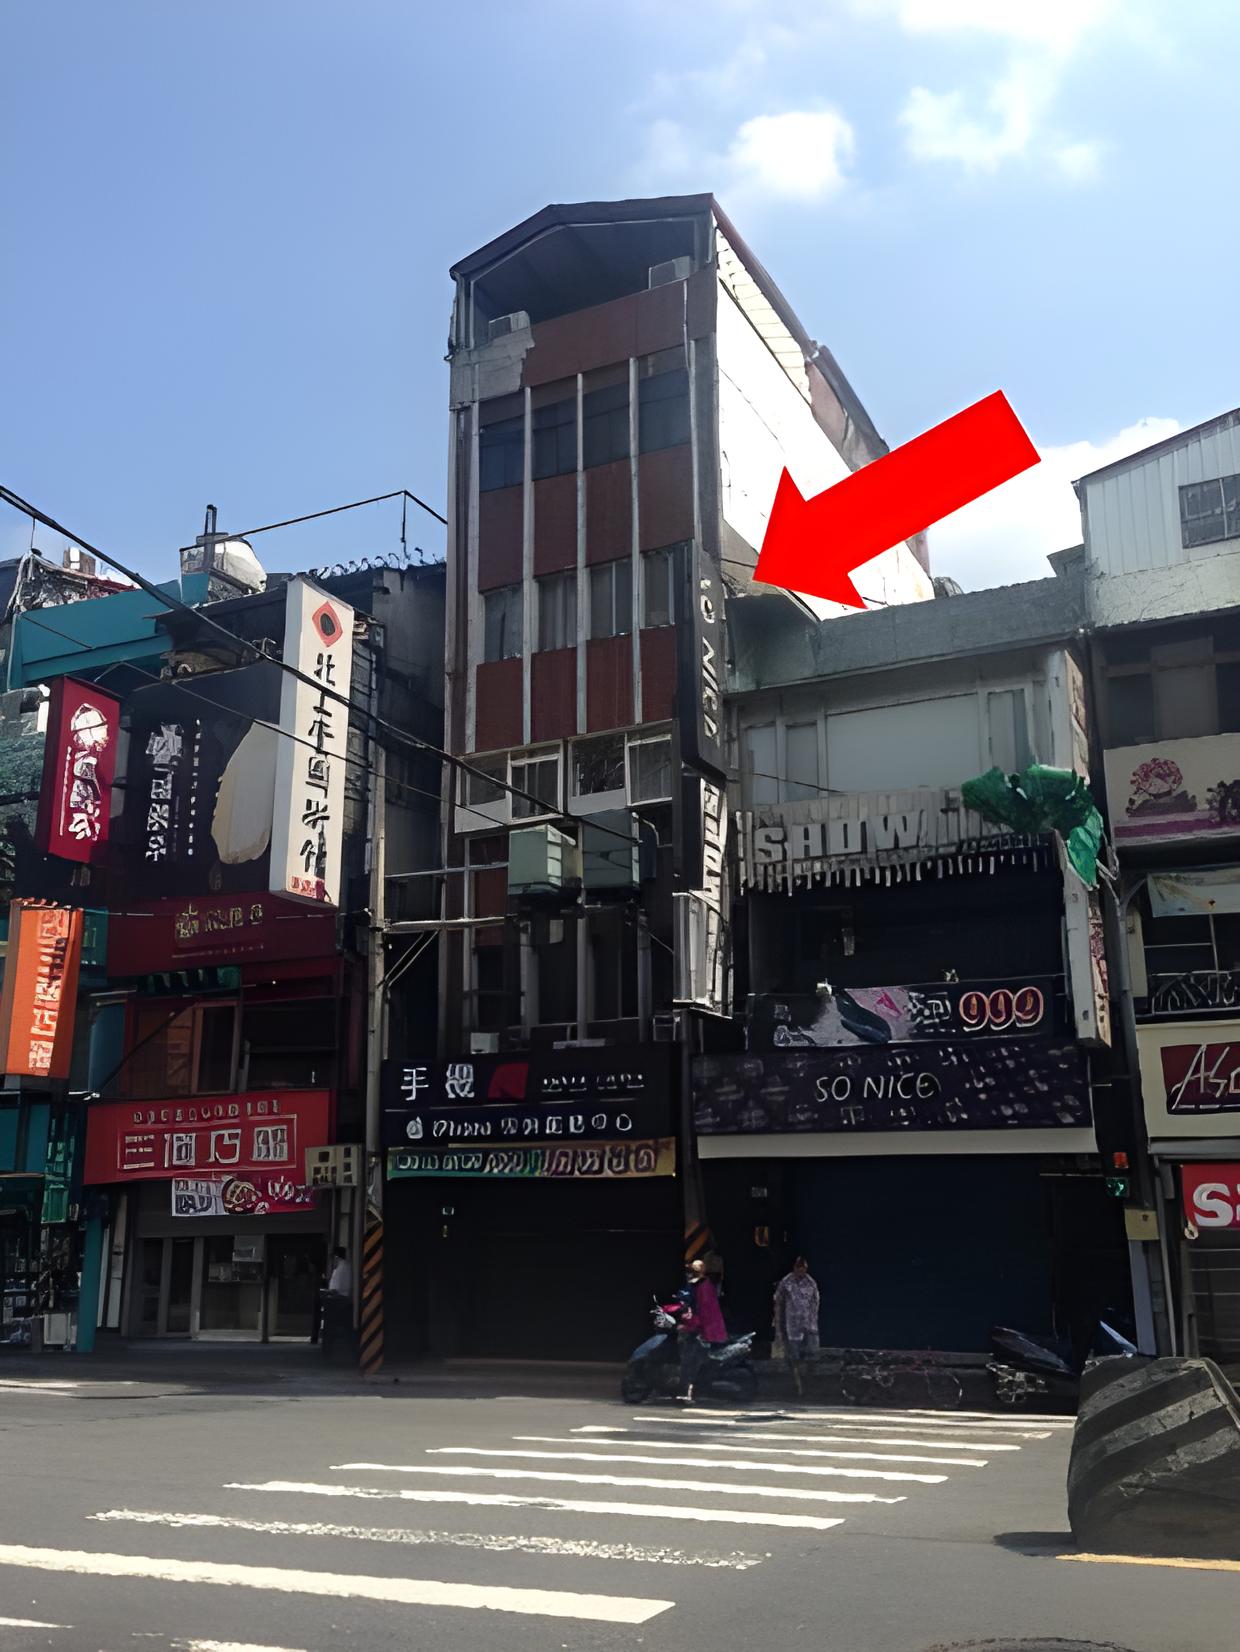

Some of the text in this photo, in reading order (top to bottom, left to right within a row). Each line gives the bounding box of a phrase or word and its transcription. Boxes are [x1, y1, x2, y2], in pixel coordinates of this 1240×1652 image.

[959, 986, 1044, 1032] 999
[815, 1072, 939, 1101] SO NICE
[1193, 1183, 1240, 1227] S
